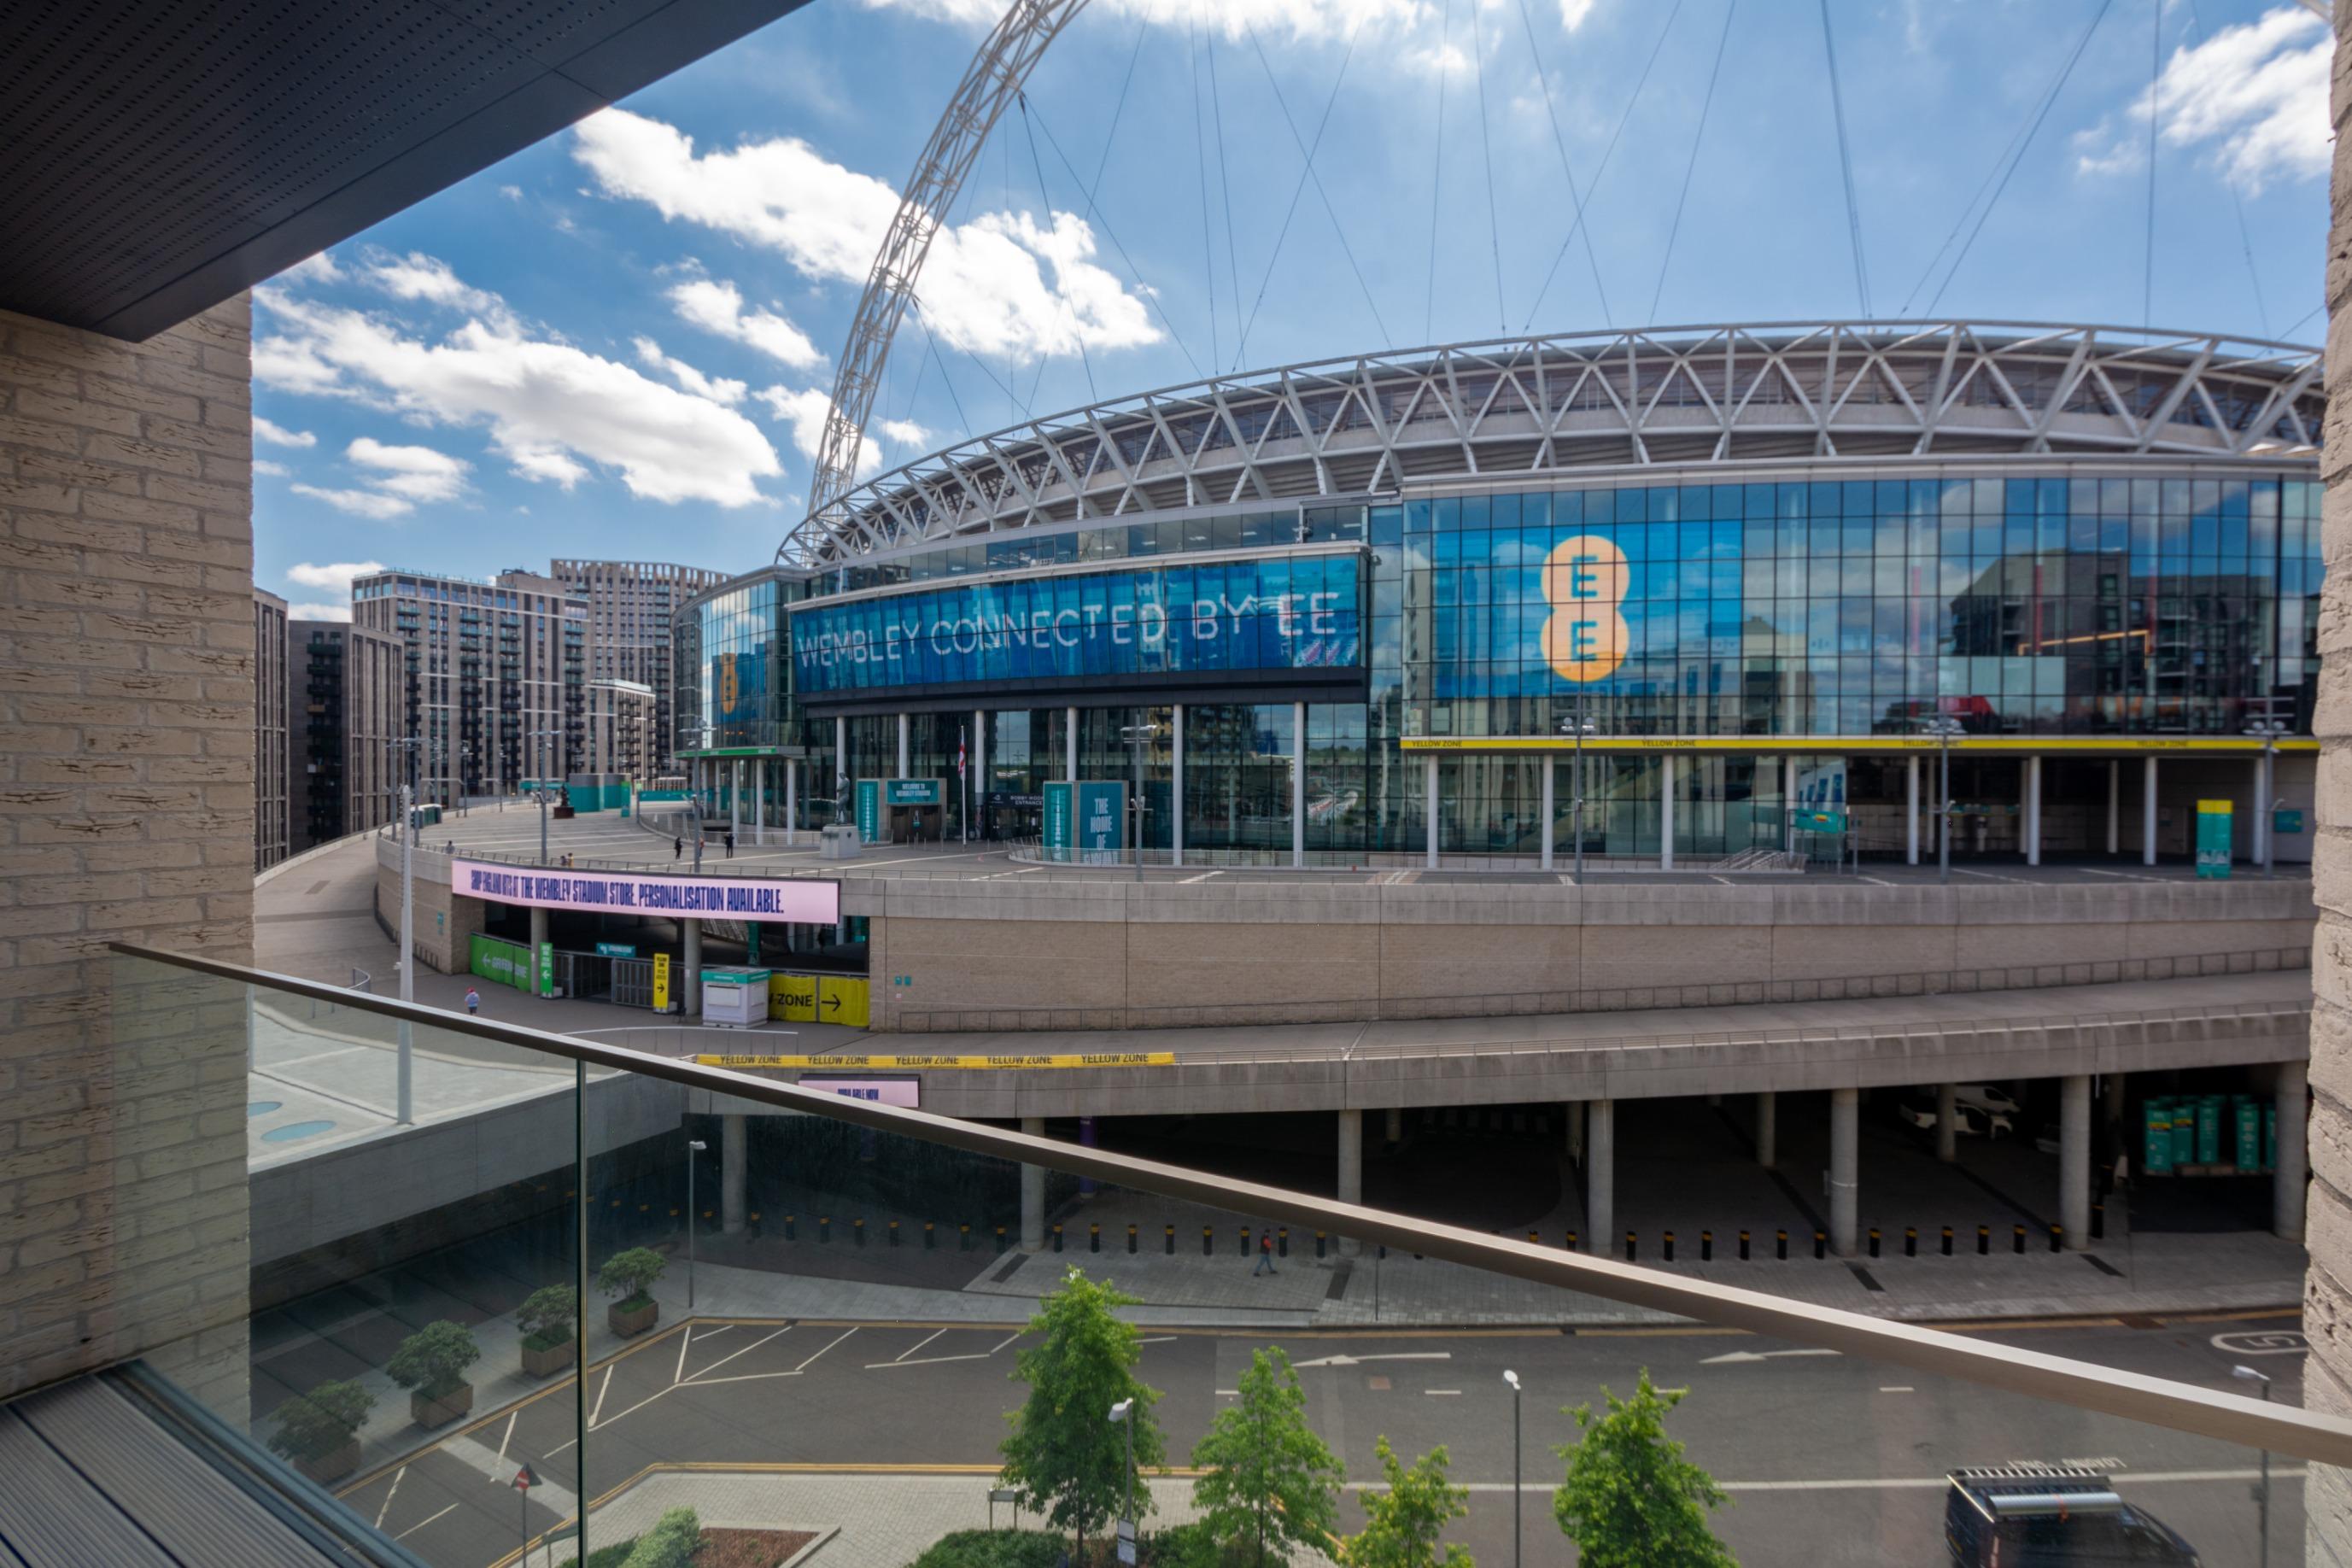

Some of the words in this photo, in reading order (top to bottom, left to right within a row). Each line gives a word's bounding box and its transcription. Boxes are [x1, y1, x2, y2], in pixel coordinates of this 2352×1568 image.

[797, 619, 921, 668] WEMBLEY
[930, 603, 1166, 655] CONNECTED
[1191, 593, 1253, 640] BY
[1278, 592, 1340, 636] EE
[1641, 739, 1673, 747] YELLOW
[1675, 739, 1695, 747] ZONE
[1094, 798, 1109, 814] THE
[1090, 816, 1113, 833] HOME
[1097, 834, 1107, 850] OF
[521, 876, 534, 899] THE
[535, 877, 571, 902] WEMBLEY
[572, 880, 608, 905] STADIUM
[610, 882, 637, 906] STORE.
[639, 883, 724, 911] PERSONALISATION
[727, 887, 784, 914] AVAILABLE.
[777, 994, 812, 1008] ZONE
[720, 1055, 756, 1064] YELLOW
[758, 1055, 781, 1064] ZONE
[807, 1056, 844, 1065] YELLOW
[845, 1056, 869, 1065] ZONE
[896, 1056, 932, 1065] YELLOW
[934, 1056, 959, 1065] ZONE
[986, 1056, 1024, 1065] YELLOW
[1027, 1056, 1052, 1065] ZONE
[1081, 1054, 1120, 1064] YELLOW
[1123, 1053, 1149, 1063] ZONE
